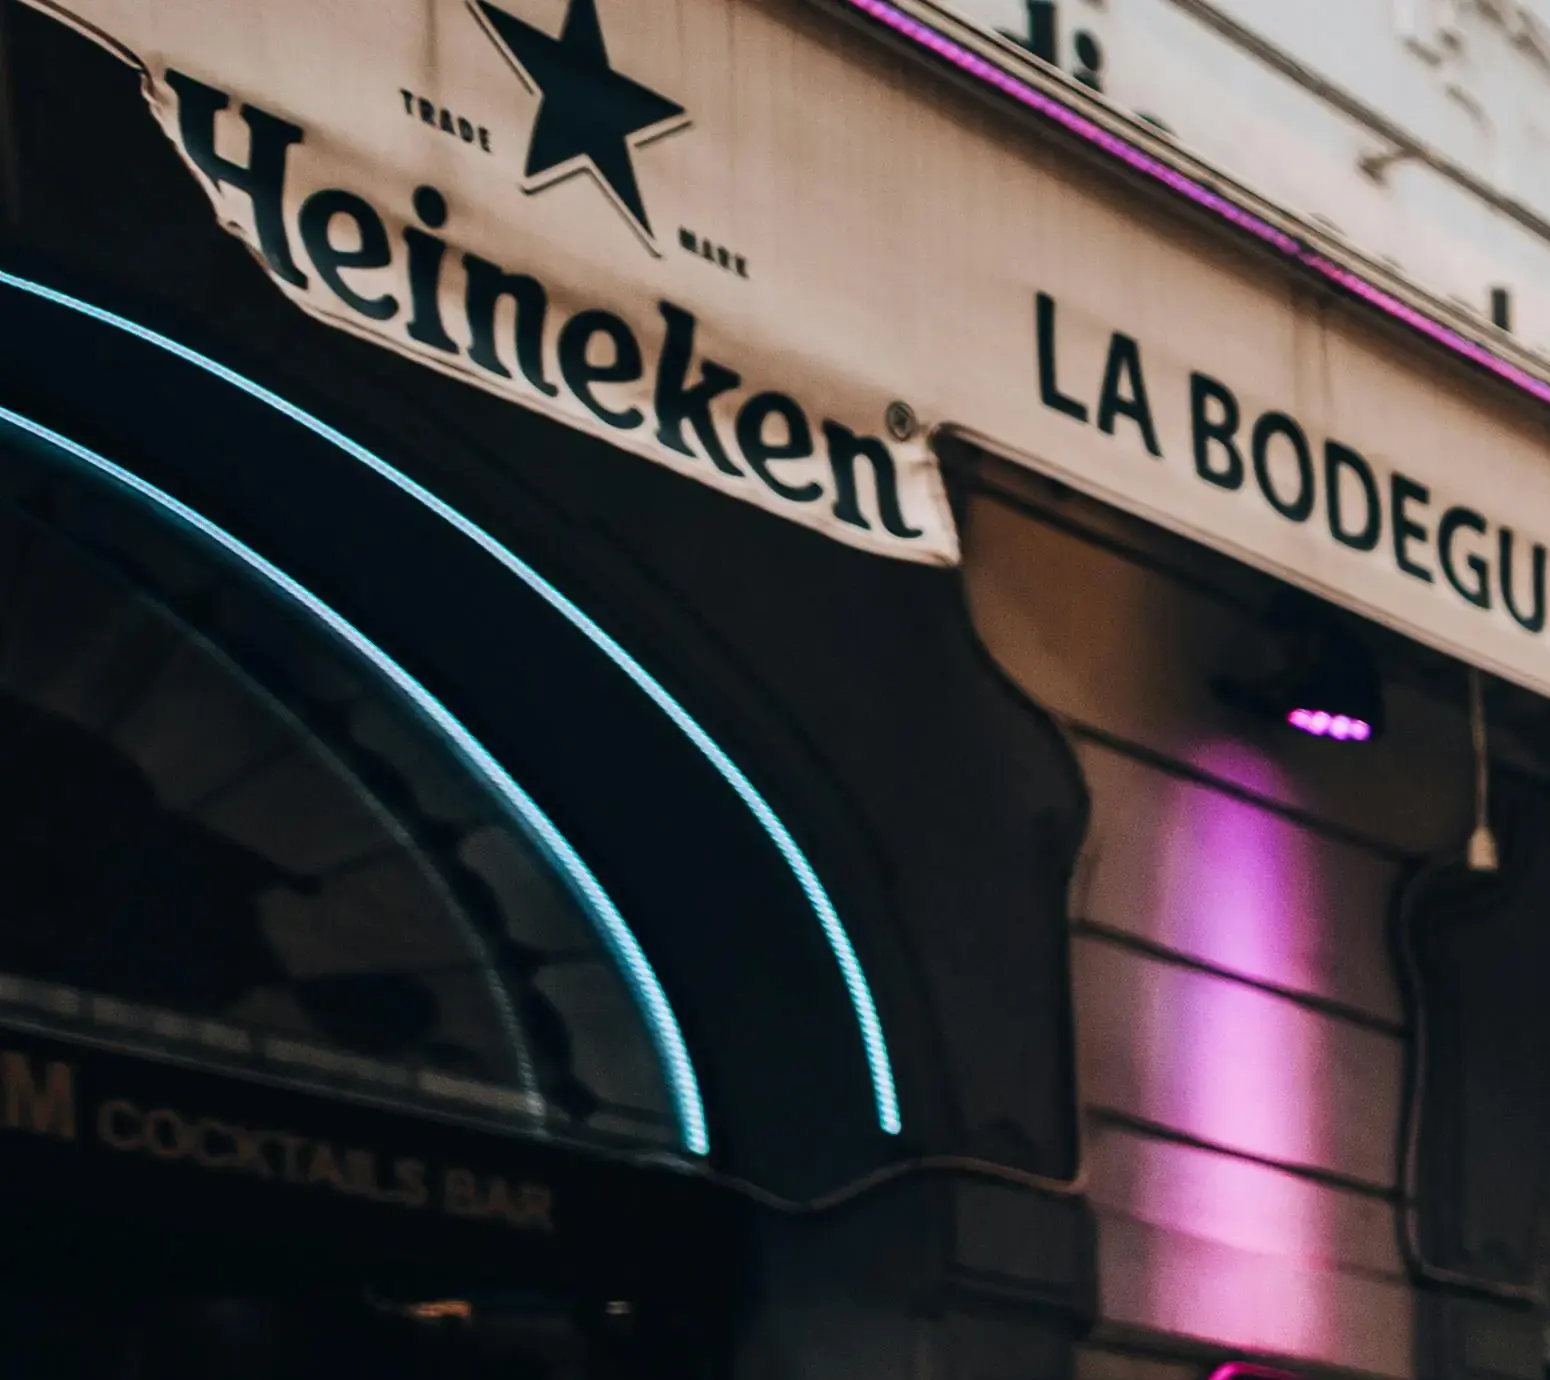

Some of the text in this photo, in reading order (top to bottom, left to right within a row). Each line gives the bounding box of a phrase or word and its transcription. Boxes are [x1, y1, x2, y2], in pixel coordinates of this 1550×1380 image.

[400, 88, 492, 153] TRADE
[163, 67, 922, 540] Heineken
[1035, 289, 1163, 459] LA
[97, 1098, 430, 1208] COCKTAILS
[445, 1166, 554, 1231] BAR
